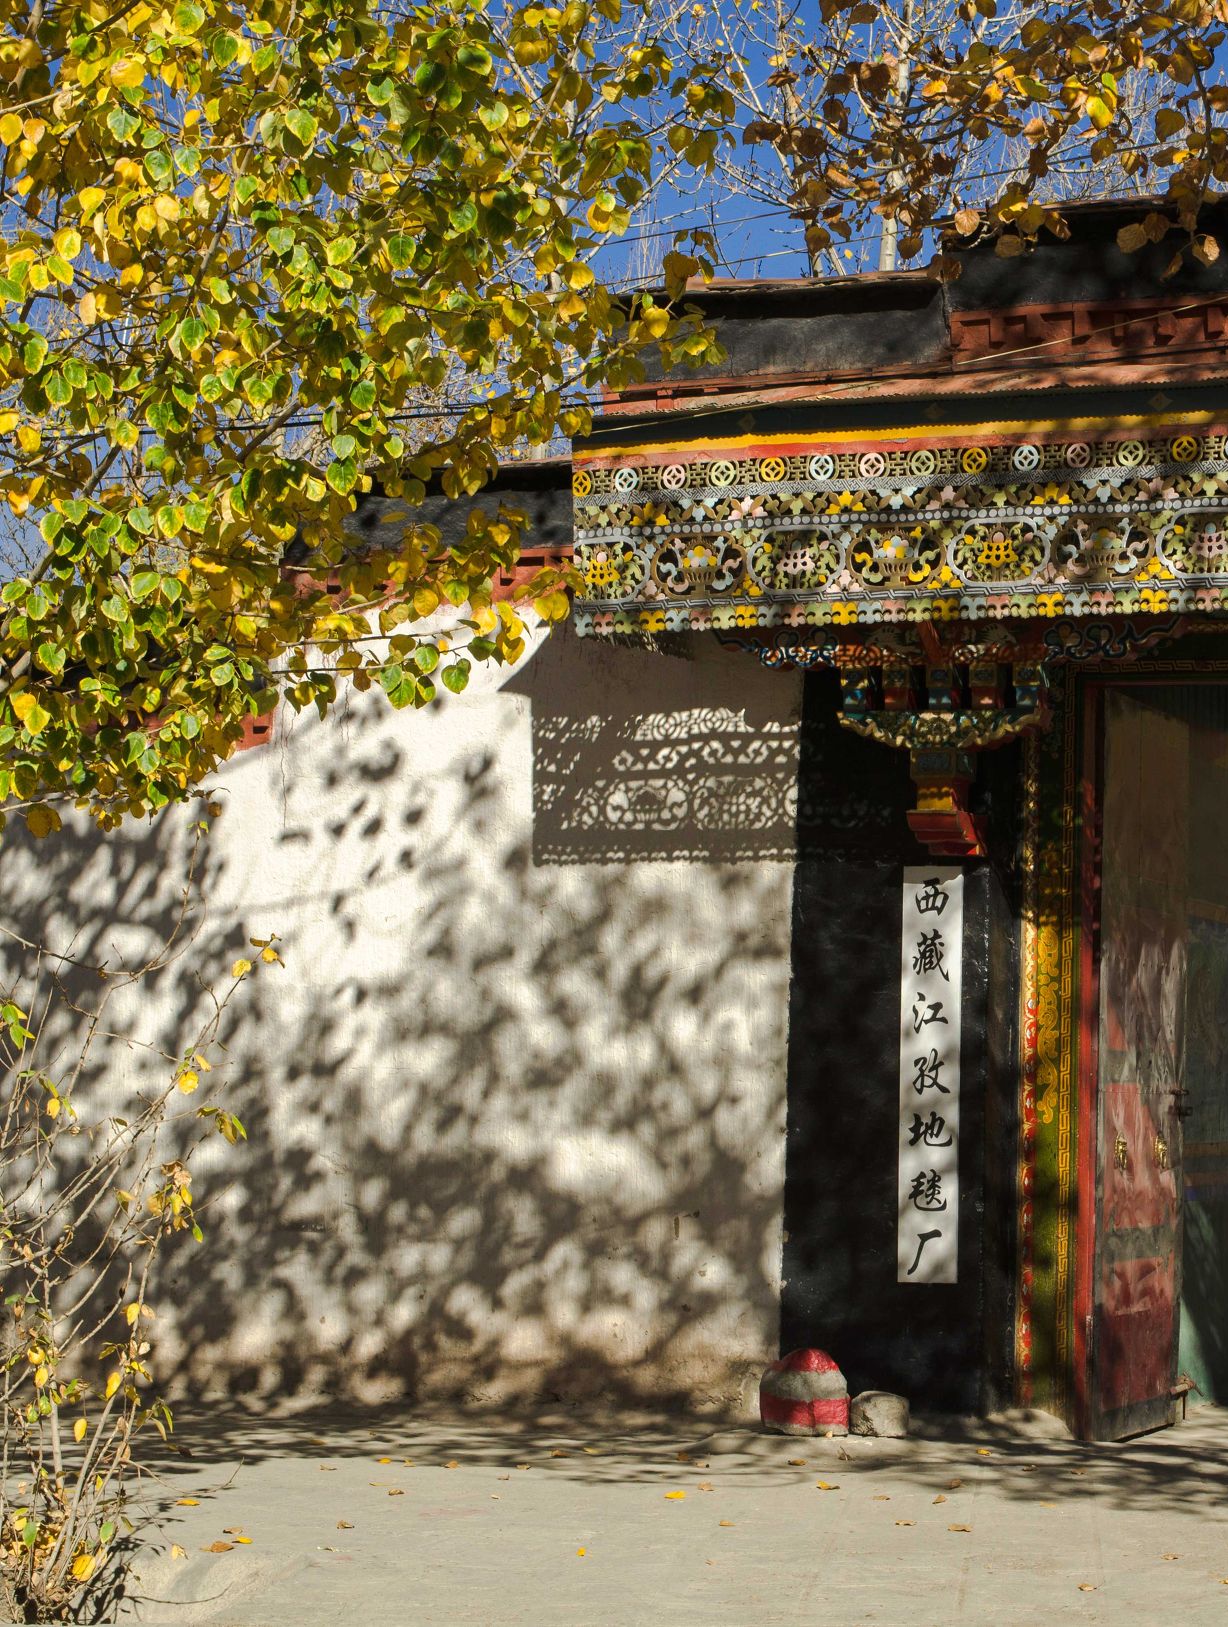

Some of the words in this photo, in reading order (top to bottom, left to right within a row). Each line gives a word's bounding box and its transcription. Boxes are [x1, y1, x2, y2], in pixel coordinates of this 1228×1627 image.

[908, 879, 952, 1275] 西藏江孜地毯厂
